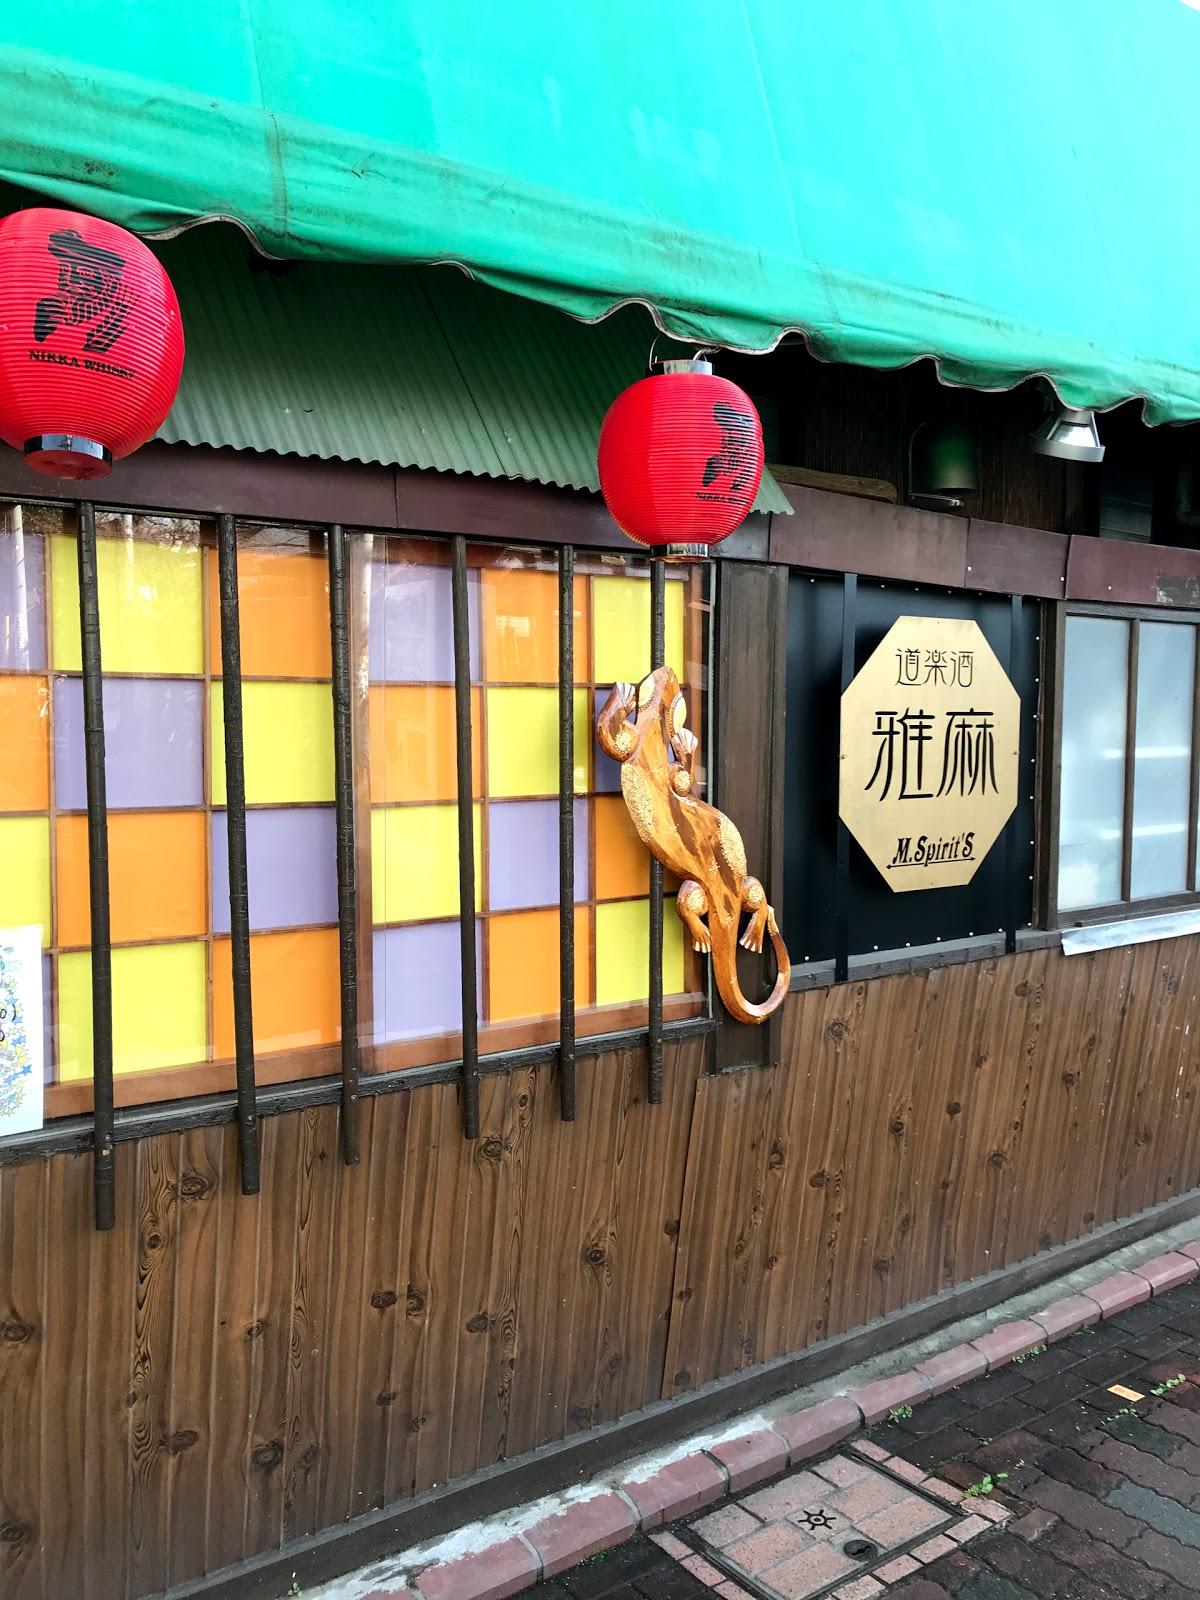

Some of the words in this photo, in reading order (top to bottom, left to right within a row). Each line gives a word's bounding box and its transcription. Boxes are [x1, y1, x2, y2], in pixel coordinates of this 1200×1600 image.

[28, 350, 81, 368] NIKKA
[895, 648, 974, 688] 道楽酒
[864, 708, 999, 802] 雅麻
